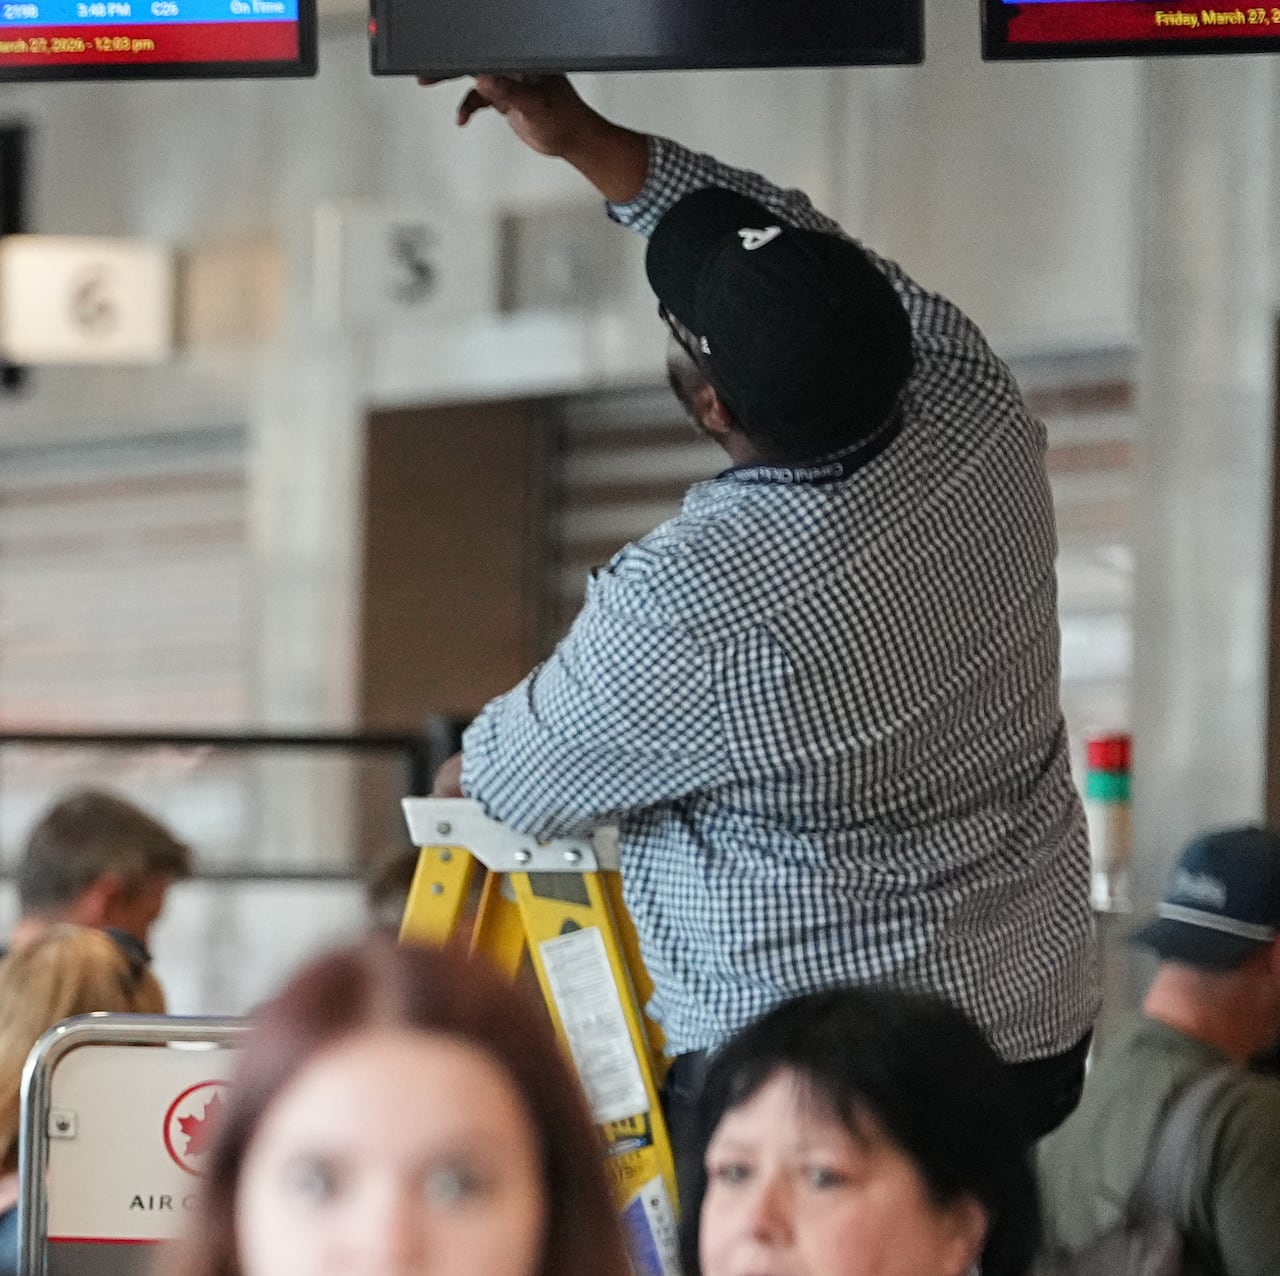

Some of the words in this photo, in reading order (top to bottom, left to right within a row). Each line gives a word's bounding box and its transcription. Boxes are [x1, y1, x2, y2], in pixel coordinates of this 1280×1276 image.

[1154, 10, 1201, 28] Friday,
[1202, 9, 1246, 26] March
[1247, 8, 1270, 26] 27,
[132, 38, 155, 54] pm
[129, 1194, 173, 1211] AIR
